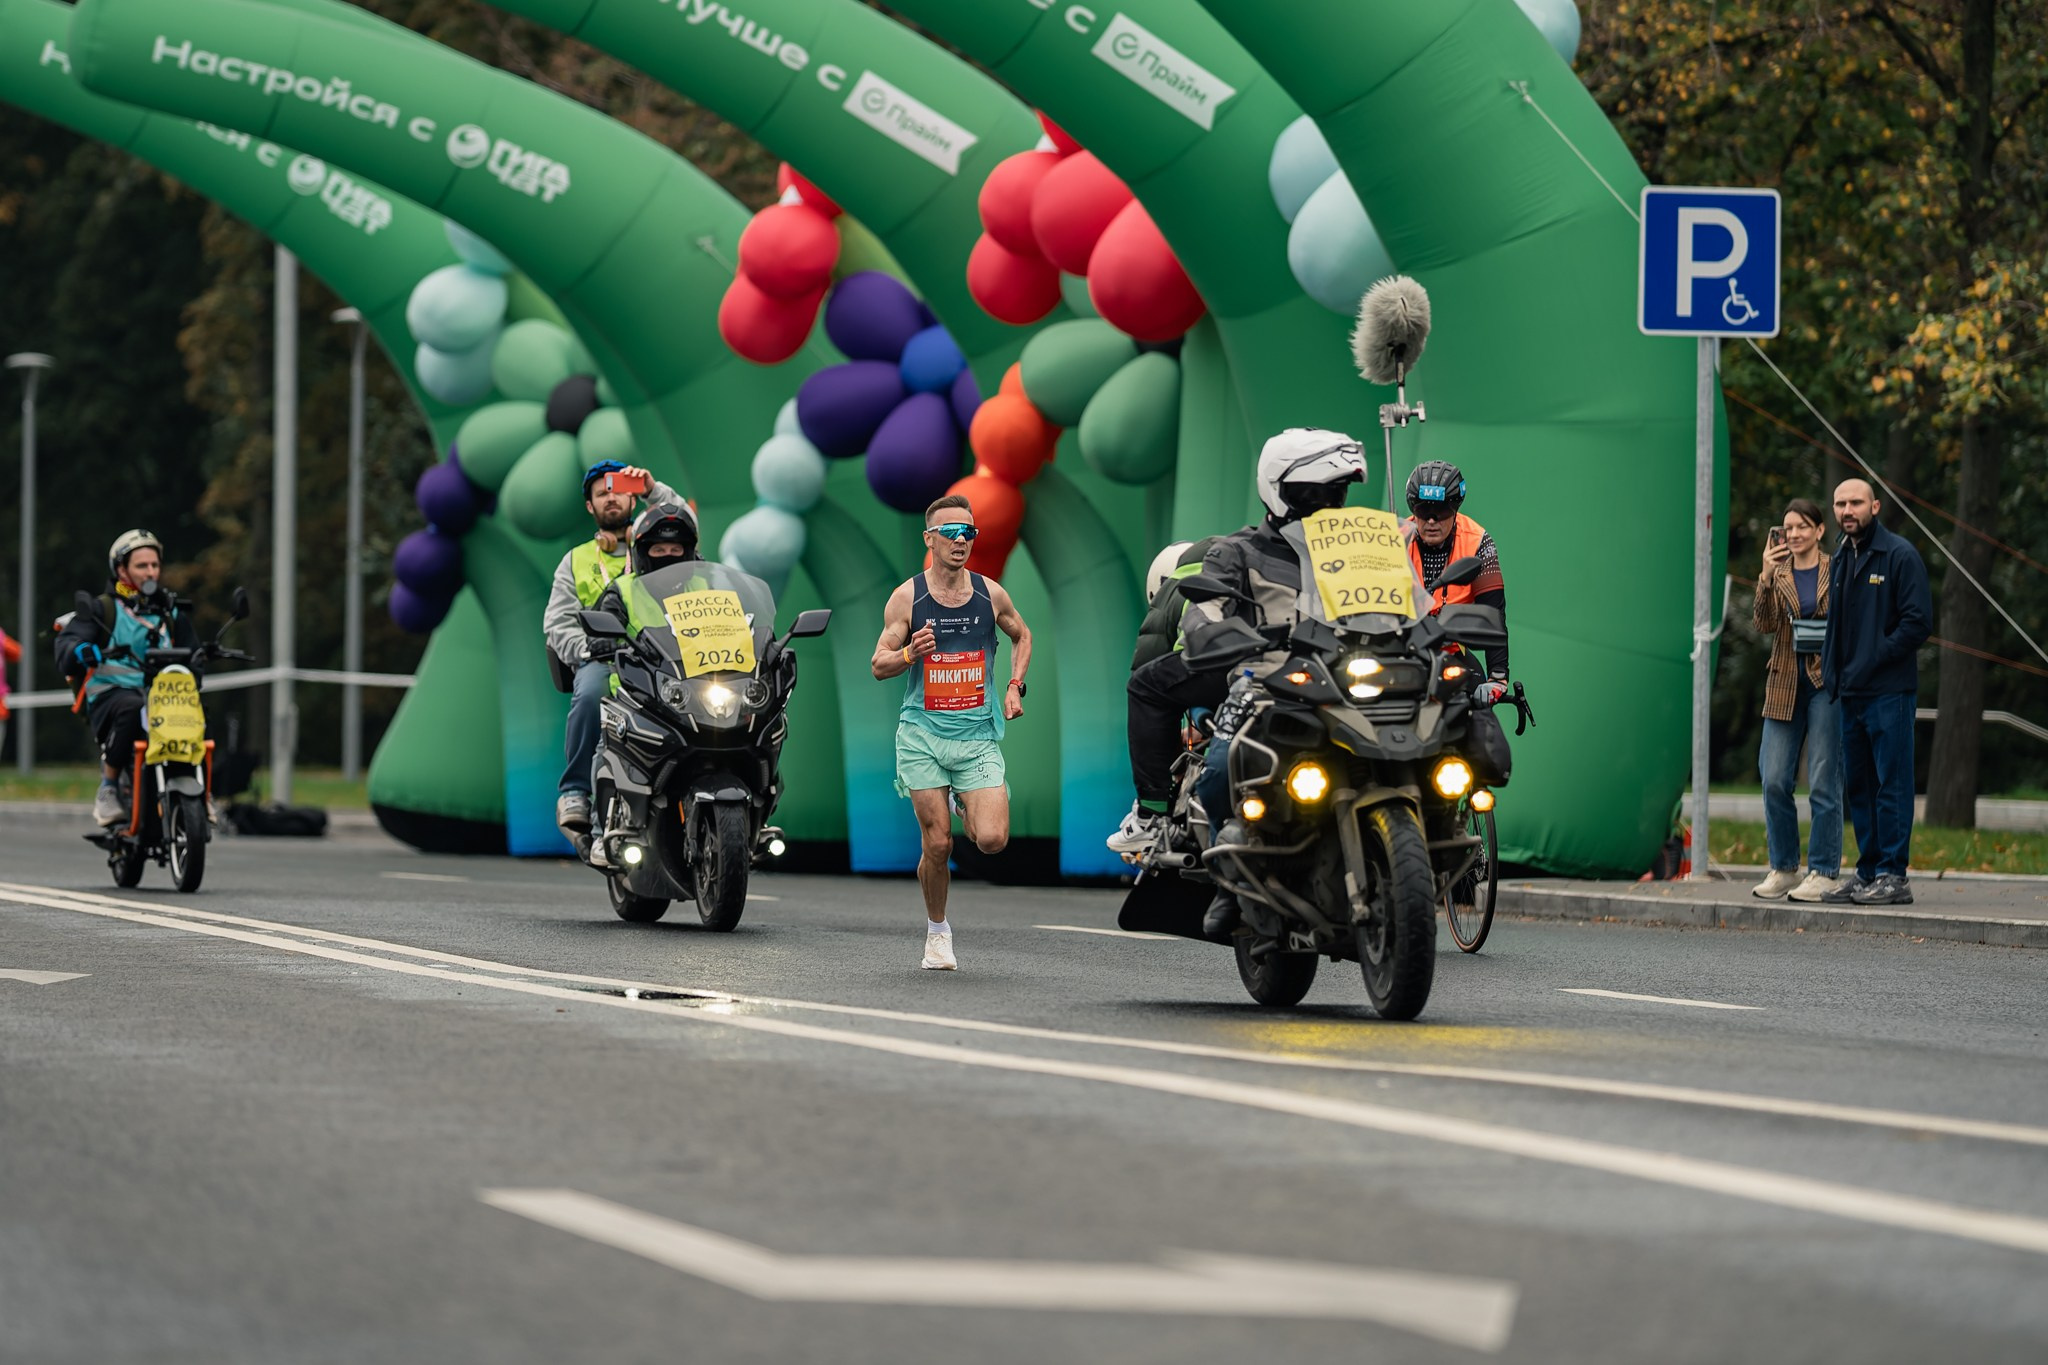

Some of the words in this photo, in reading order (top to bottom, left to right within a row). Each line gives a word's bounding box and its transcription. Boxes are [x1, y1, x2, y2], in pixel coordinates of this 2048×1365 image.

[1065, 5, 1096, 34] с
[816, 64, 847, 91] с
[1138, 50, 1208, 105] Прайм
[152, 35, 400, 129] Настройся
[408, 116, 437, 142] с
[886, 103, 952, 153] Прайм
[1676, 207, 1748, 318] P
[1316, 516, 1392, 533] ТРАССА
[1311, 531, 1402, 551] ПРОПУСК
[674, 597, 733, 611] ТРАССА
[1337, 587, 1403, 607] 2026
[672, 607, 742, 622] ПРОПУСК
[695, 649, 745, 668] 2026
[929, 666, 983, 684] НИКИТИН
[158, 682, 199, 693] РАСС
